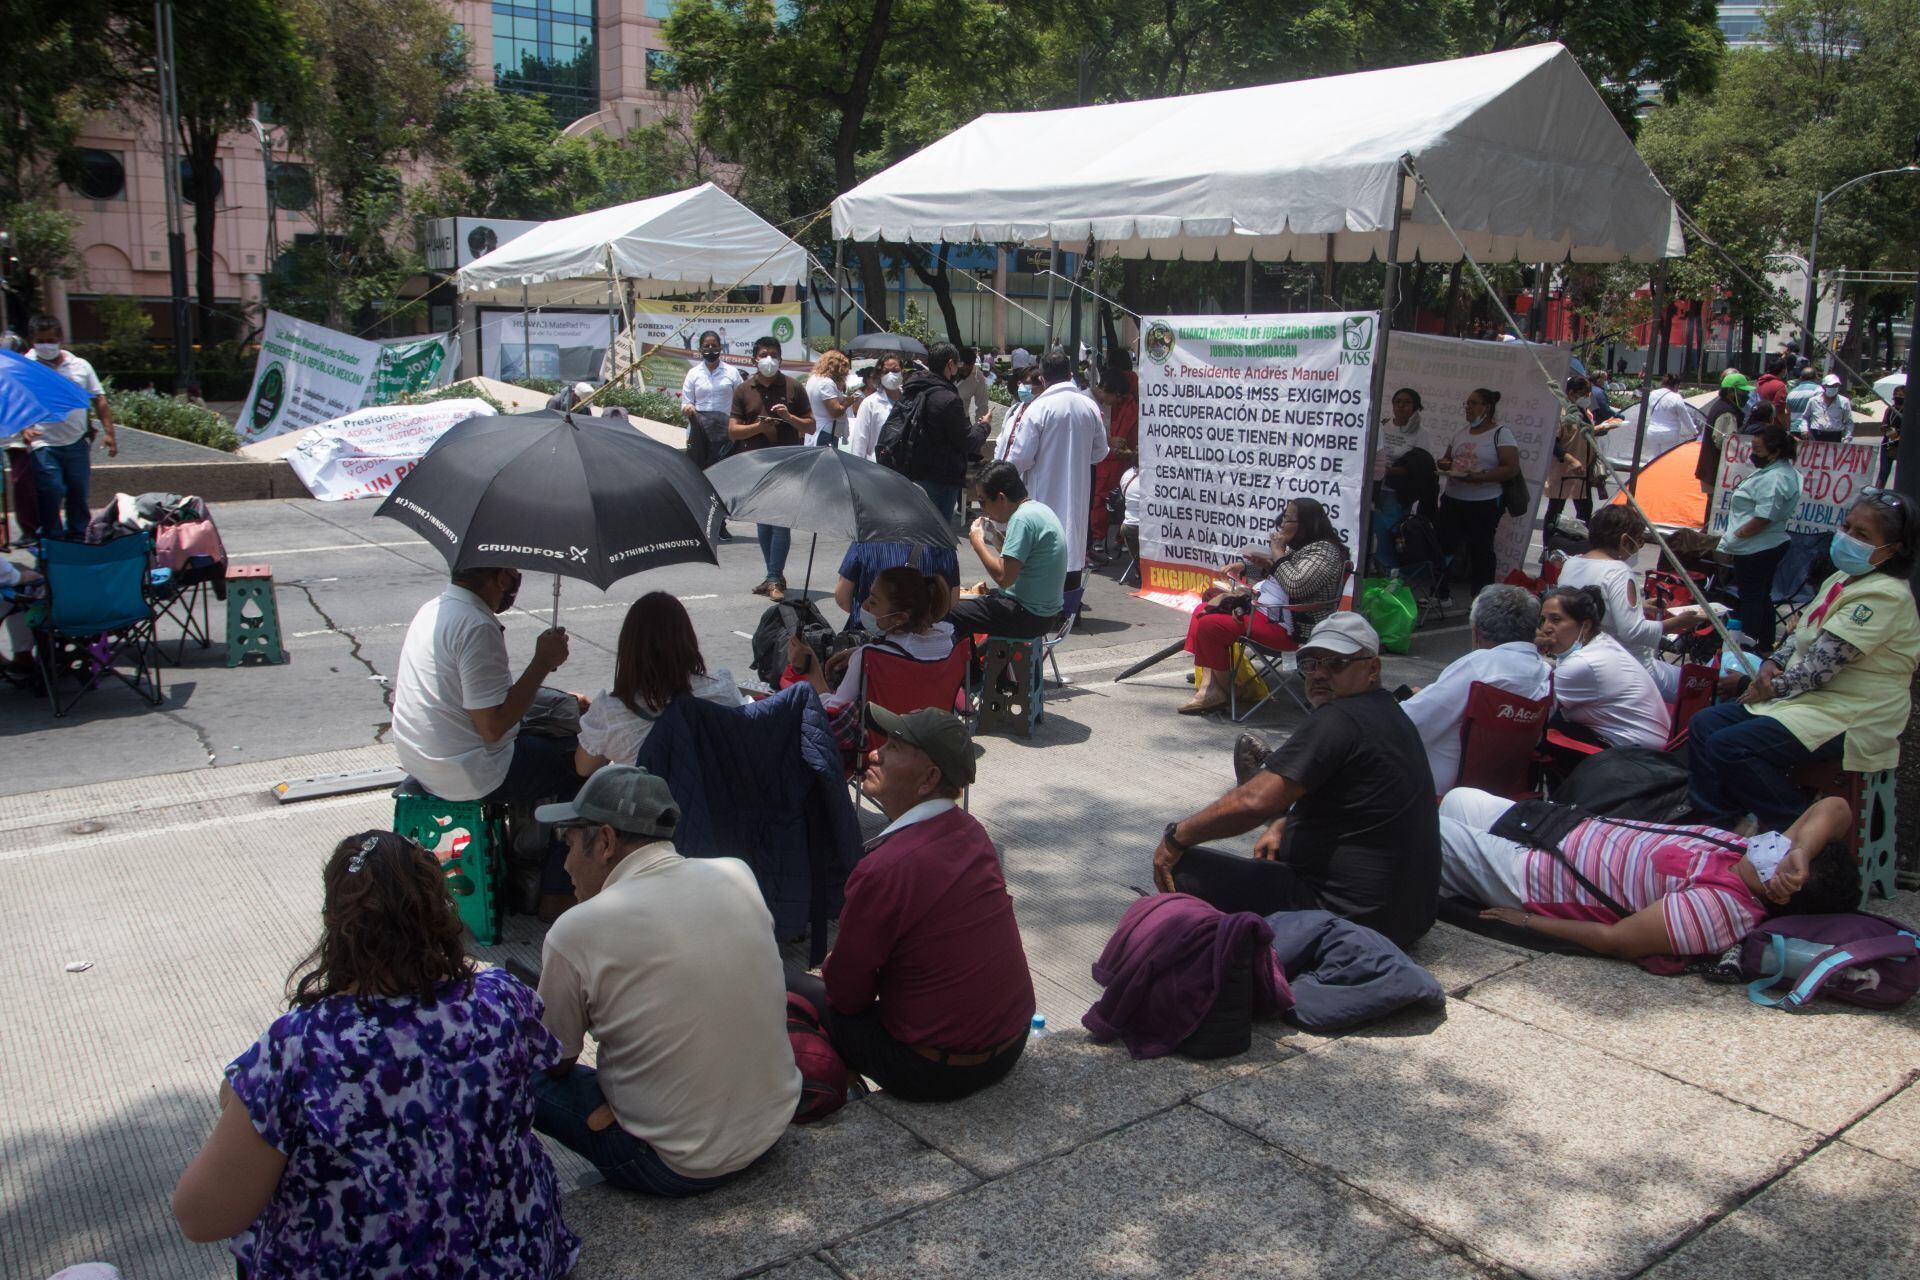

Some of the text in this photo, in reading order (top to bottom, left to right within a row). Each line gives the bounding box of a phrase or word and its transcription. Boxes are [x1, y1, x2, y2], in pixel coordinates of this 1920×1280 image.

[671, 305, 690, 313] SR.
[549, 321, 579, 329] MatePad
[638, 323, 674, 331] GOBIERNO
[1178, 325, 1337, 341] ALIANZA NACIONAL DE JUBILADOS IMSS
[1209, 342, 1298, 358] JUBIMSS MICHOACÁN
[1339, 351, 1371, 366] IMSS
[1163, 364, 1340, 381] Sr. Presidente Andrés Manuel
[1146, 383, 1362, 405] LOS JUBILADOS IMSS EXIGIMOS
[1141, 403, 1365, 429] LA RECUPERACIÓN DE NUESTROS
[1146, 424, 1359, 451] AHORROS QUE TIENEN NOMBRE
[1155, 443, 1344, 473] Y APELLIDO LOS RUBROS DE
[364, 473, 393, 493] UN
[1155, 465, 1342, 497] CESANTIA Y VEJEZ Y CUOTA
[1154, 484, 1197, 501] SOCIAL
[1199, 489, 1217, 504] EN
[1220, 491, 1245, 508] LAS
[1147, 503, 1193, 521] CUALES
[1194, 508, 1246, 529] FUERON
[1161, 522, 1183, 540] DÍA
[1187, 527, 1196, 541] A
[1197, 527, 1218, 546] DÍA
[477, 543, 565, 560] GRUNDFOS
[1165, 544, 1219, 567] NUESTRA
[1149, 566, 1210, 592] EXIGIMOS
